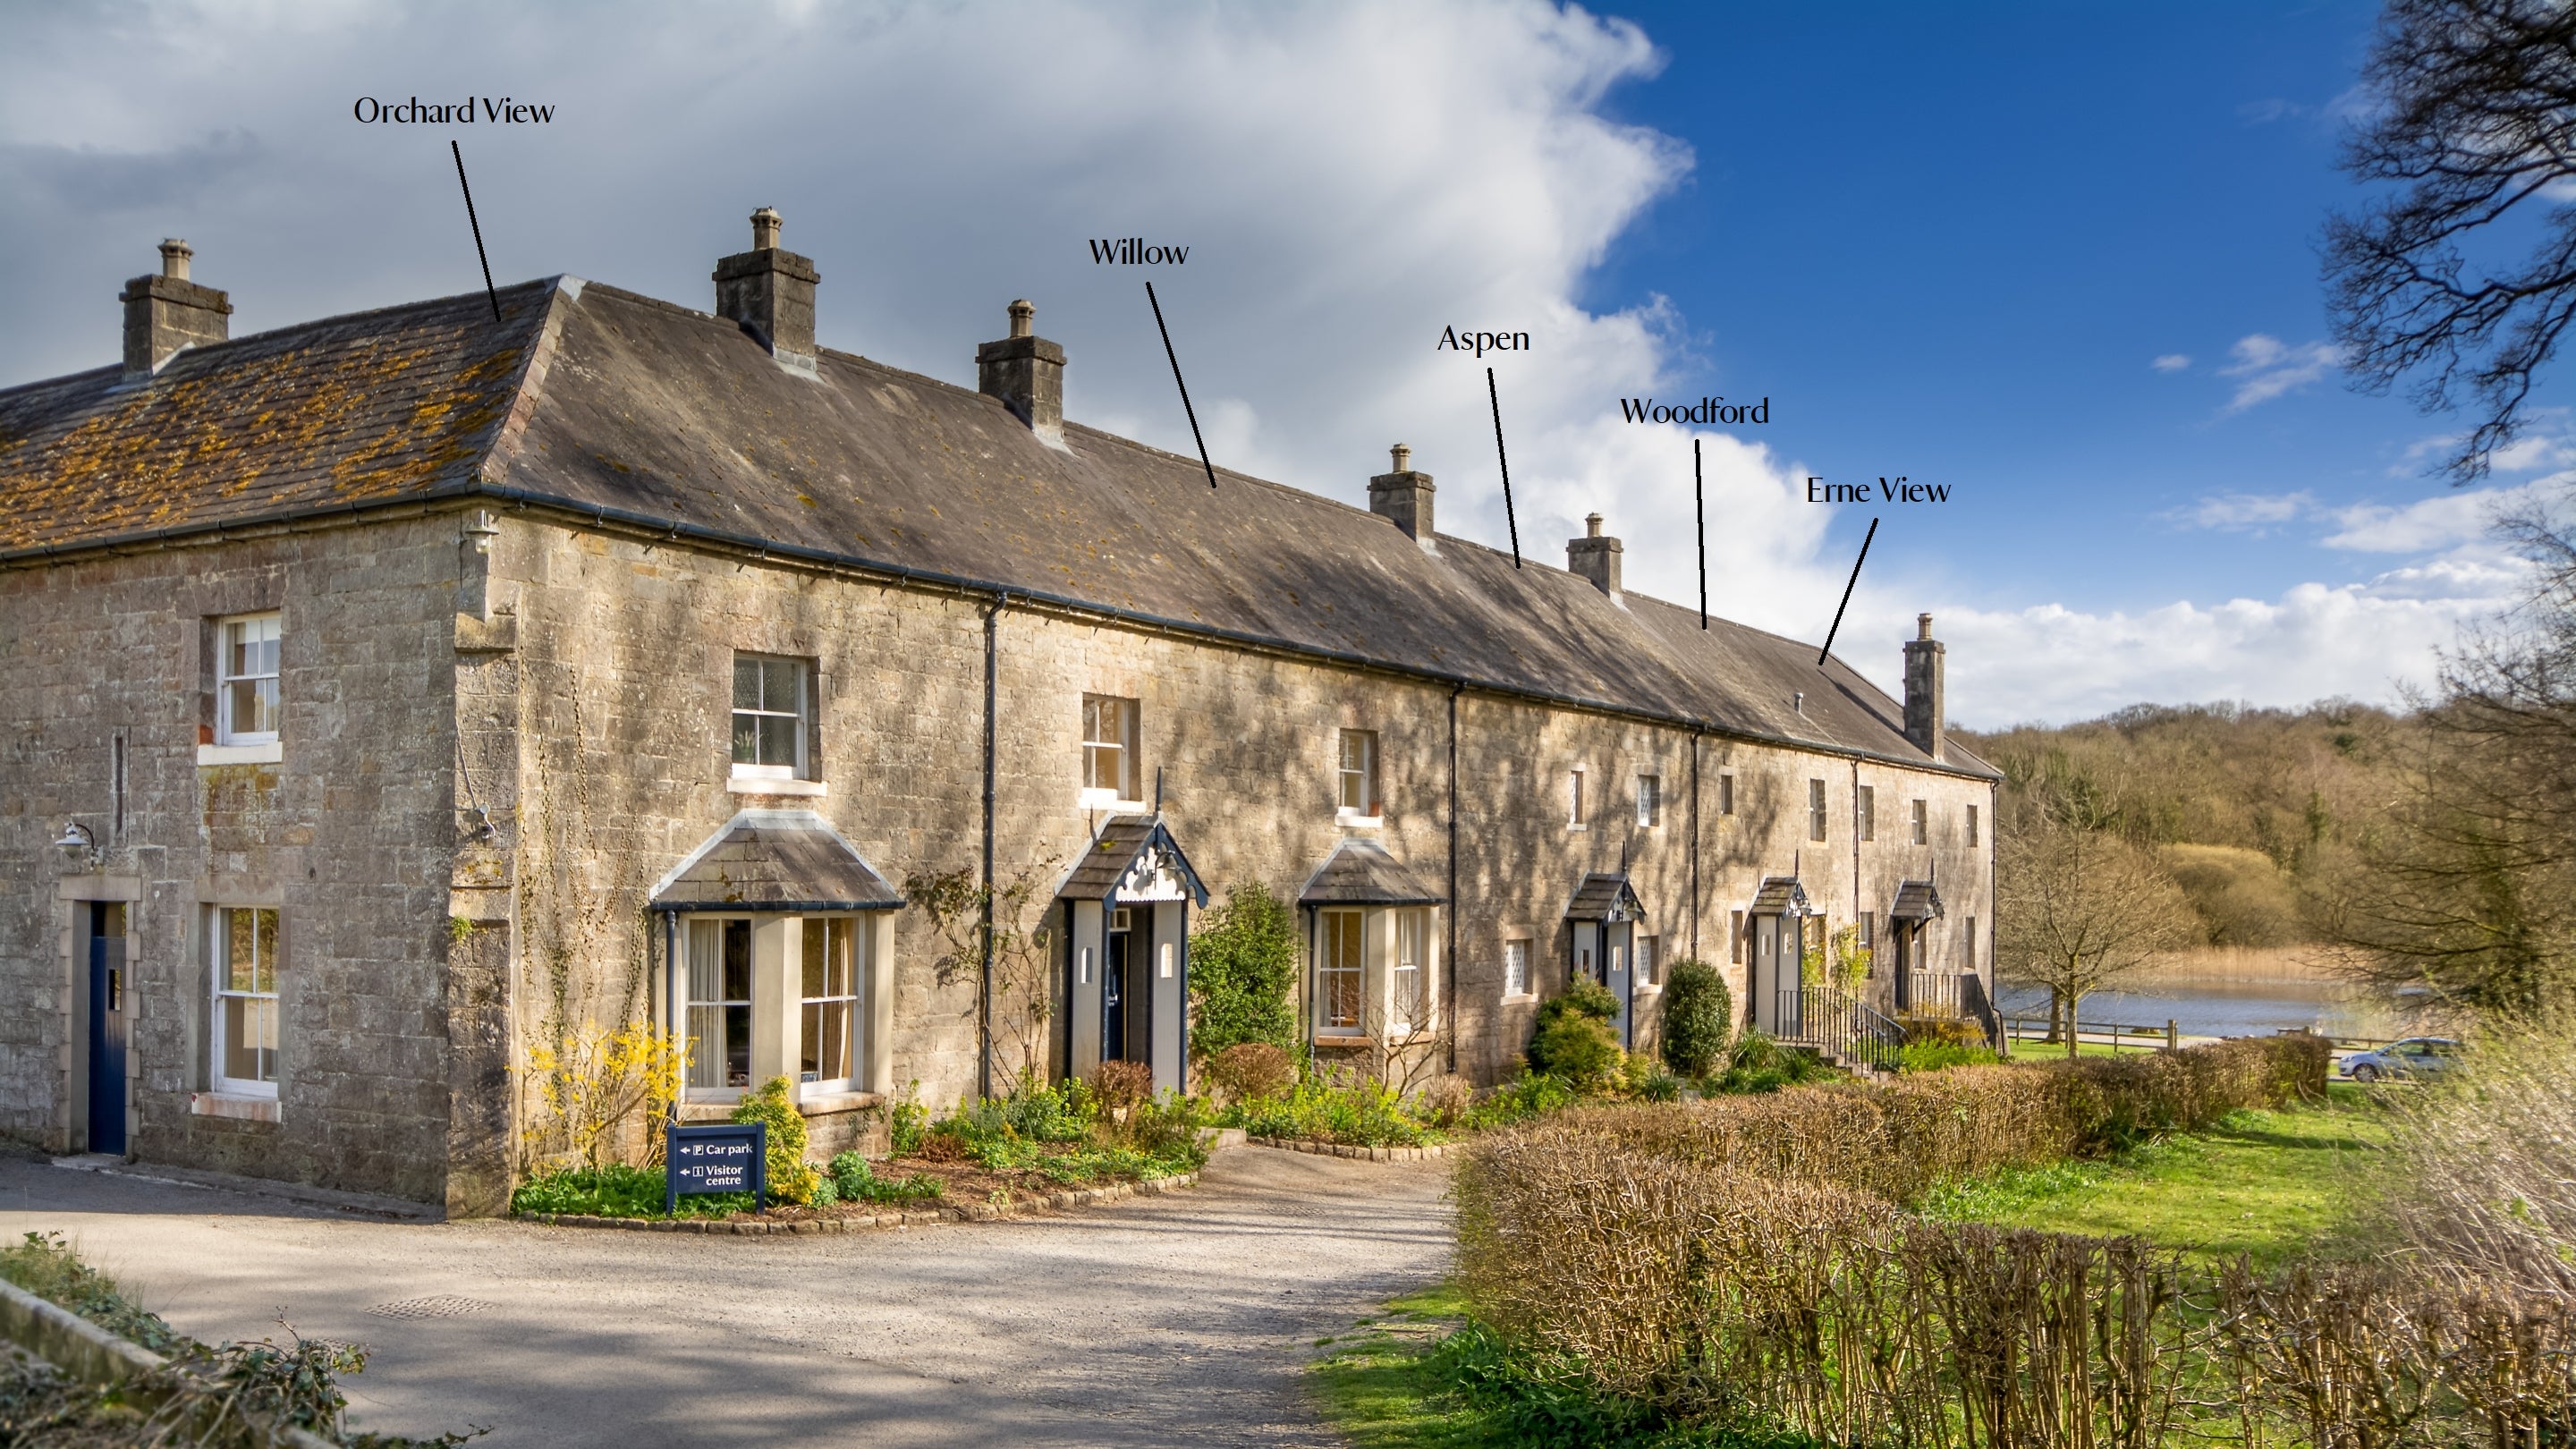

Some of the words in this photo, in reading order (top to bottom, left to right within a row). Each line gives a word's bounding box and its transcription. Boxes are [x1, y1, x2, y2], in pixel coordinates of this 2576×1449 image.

[706, 1145, 726, 1155] Car
[728, 1143, 753, 1156] park
[706, 1165, 743, 1175] Visitor
[706, 1176, 741, 1186] centre
